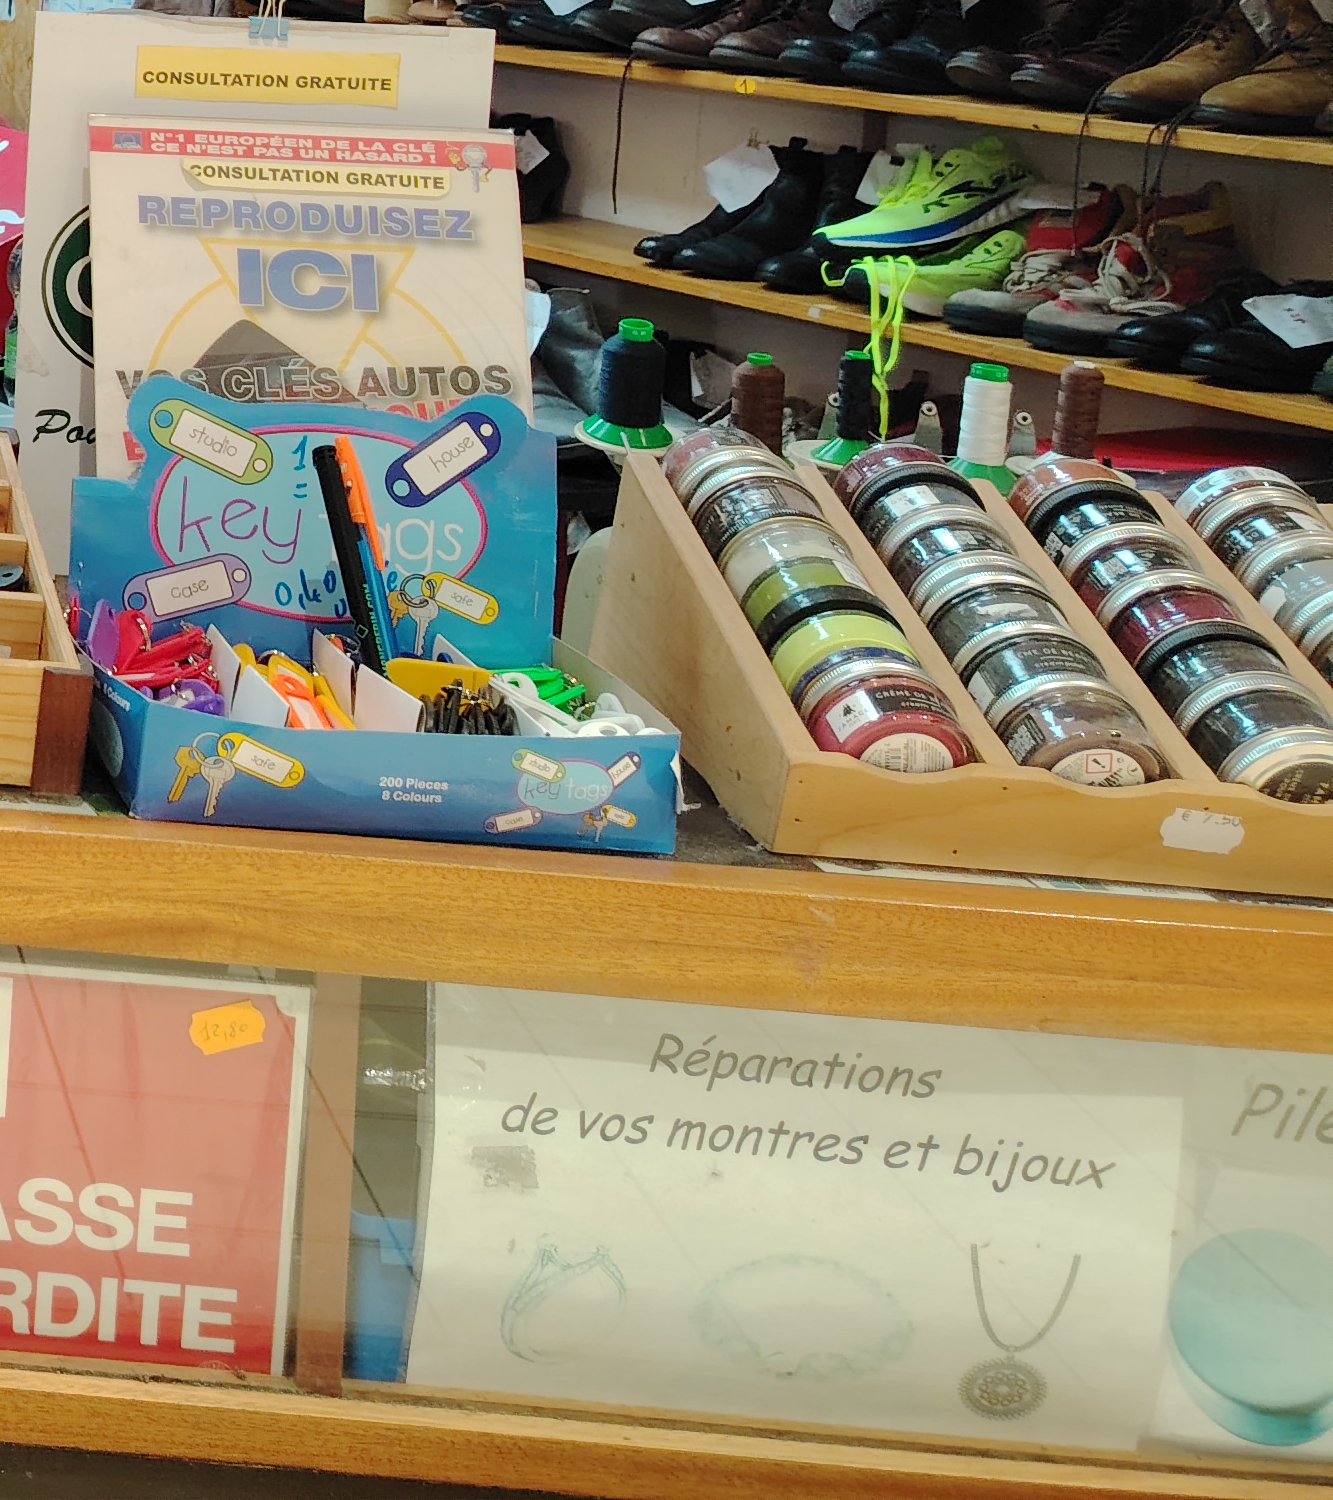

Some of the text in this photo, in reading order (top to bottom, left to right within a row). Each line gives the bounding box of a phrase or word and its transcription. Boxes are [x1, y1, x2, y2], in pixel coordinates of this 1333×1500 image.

[142, 69, 392, 92] CONSULTATION GRATUITE
[150, 131, 436, 154] N°1 EUROPÉEN DE LA CLÉ
[150, 143, 422, 163] CE N'EST PAS UN HASARD
[190, 164, 445, 190] CONSULTATION GRATUITE
[137, 195, 474, 240] REPRODUISEZ
[236, 247, 380, 312] ICI
[221, 358, 341, 400] CLÉS
[356, 366, 512, 398] AUTOS
[188, 426, 239, 459] studio
[431, 434, 476, 473] house
[179, 476, 302, 564] key
[170, 577, 209, 598] case
[450, 590, 475, 609] safe
[250, 753, 277, 770] safe
[379, 776, 449, 793] 200 Pieces
[382, 790, 442, 804] 8 Colours
[523, 778, 609, 802] key tags
[649, 1031, 942, 1100] Réparations
[499, 1091, 1118, 1193] de vos montres et bijoux
